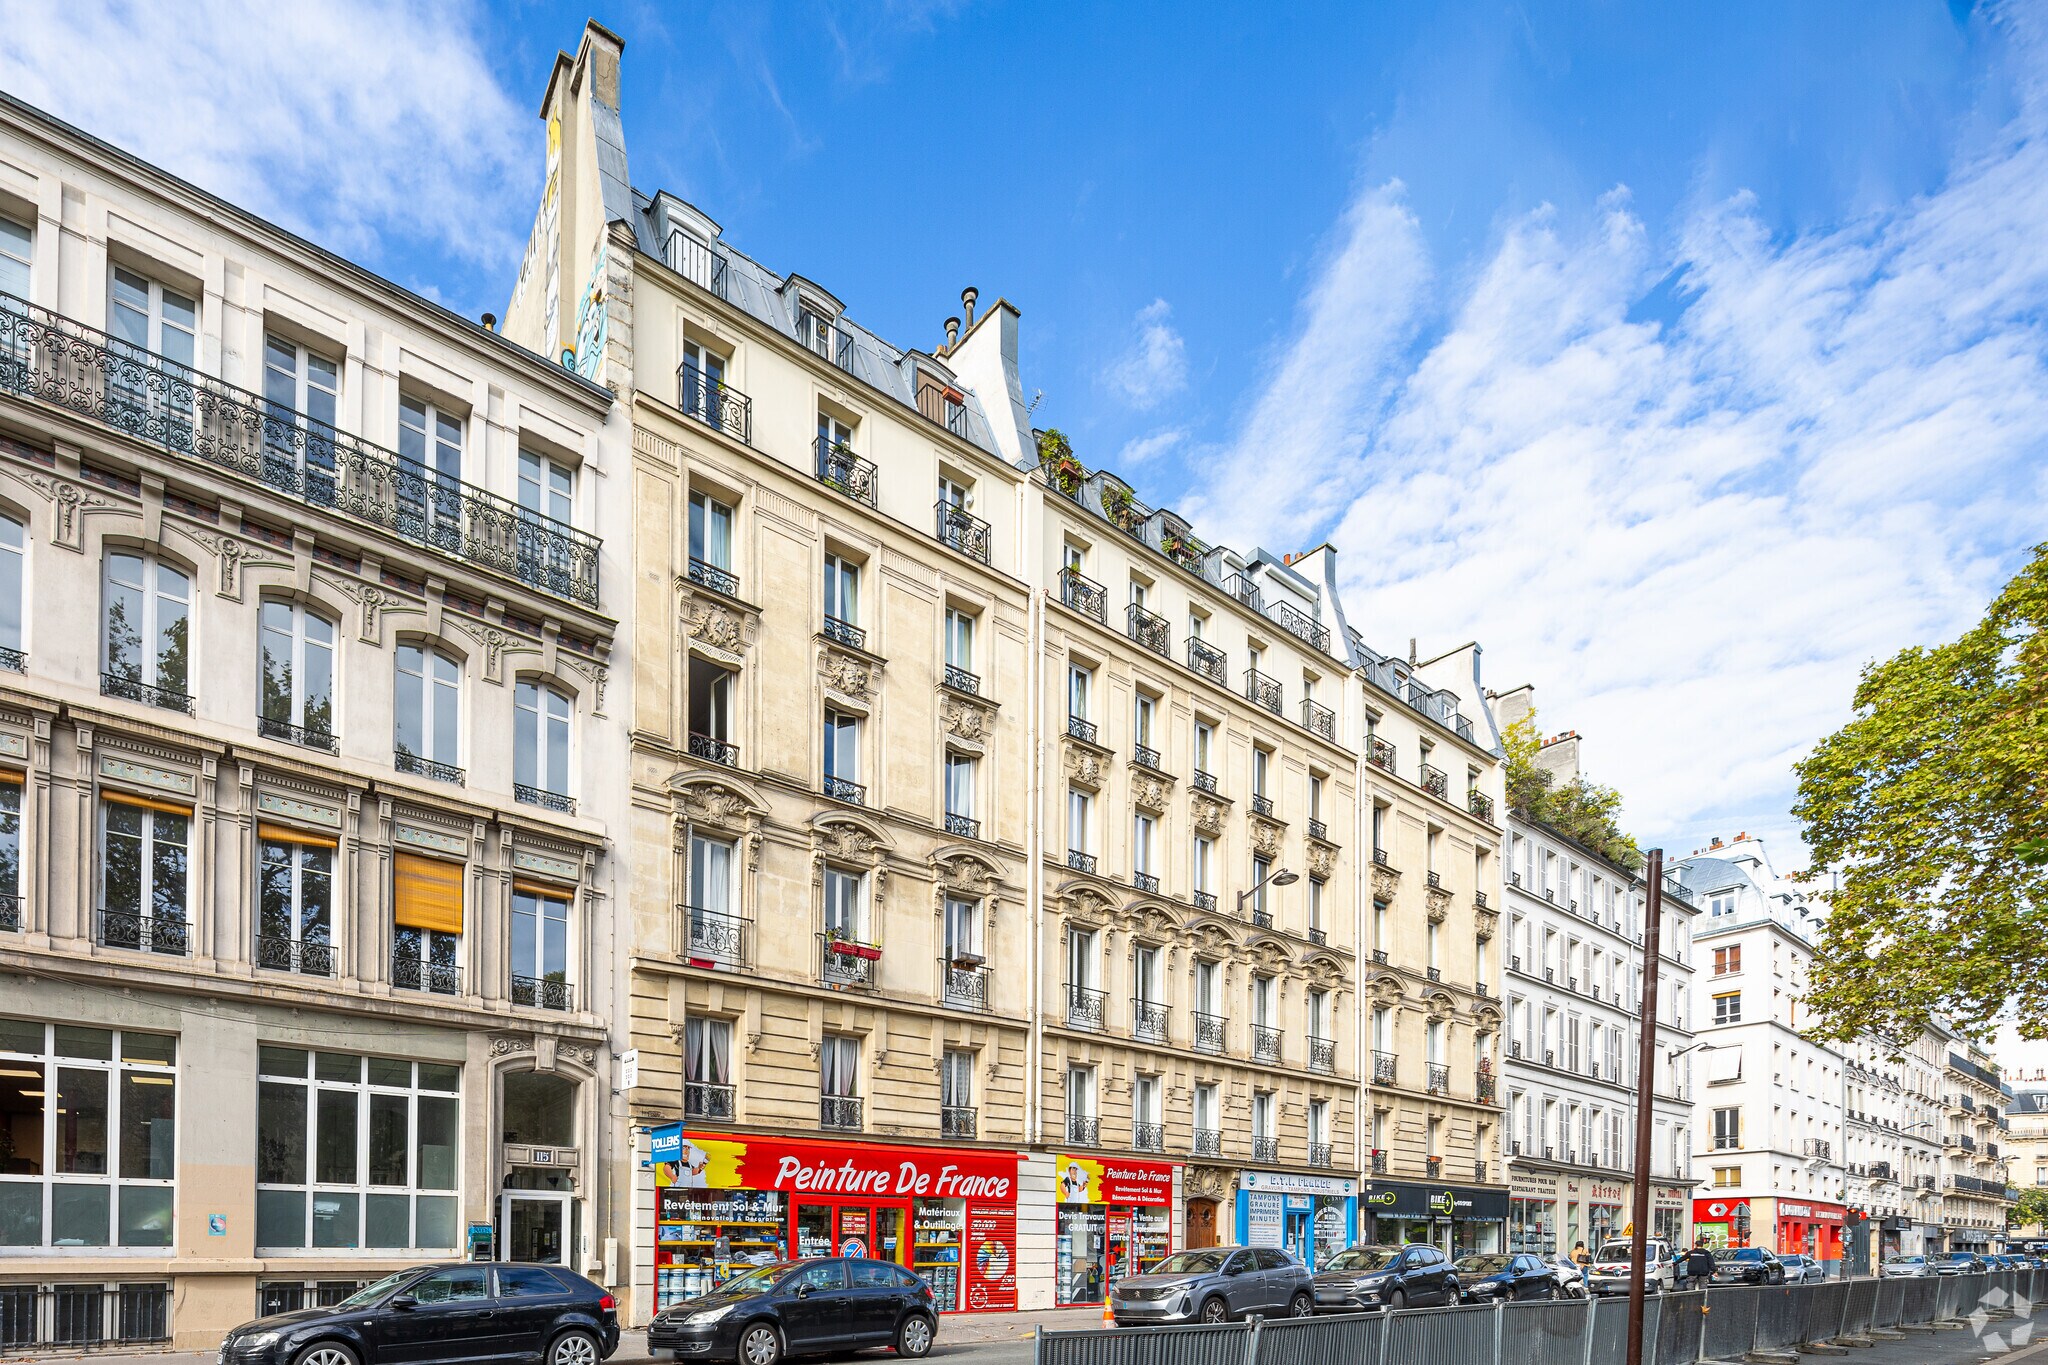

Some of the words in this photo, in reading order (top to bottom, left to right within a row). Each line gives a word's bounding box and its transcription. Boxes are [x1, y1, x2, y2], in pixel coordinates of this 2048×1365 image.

[652, 1135, 680, 1149] TOLLENS
[536, 1151, 548, 1162] 115
[774, 1156, 890, 1192] Peinture
[895, 1162, 930, 1194] De
[935, 1165, 1009, 1197] France
[1106, 1168, 1136, 1180] Peinture
[1138, 1170, 1147, 1181] De
[1148, 1170, 1170, 1182] France
[1299, 1178, 1331, 1189] FRANCE
[1431, 1195, 1445, 1203] BIKE
[664, 1199, 730, 1211] Revêtement
[733, 1201, 748, 1212] Sol
[763, 1202, 783, 1212] Mur
[919, 1207, 960, 1216] Matériaux
[1059, 1212, 1078, 1220] Devis
[1079, 1212, 1105, 1220] Travaux
[914, 1220, 920, 1229] &
[1069, 1224, 1097, 1232] GRATUIT
[800, 1236, 829, 1246] Entrée
[1110, 1233, 1129, 1241] Entrée
